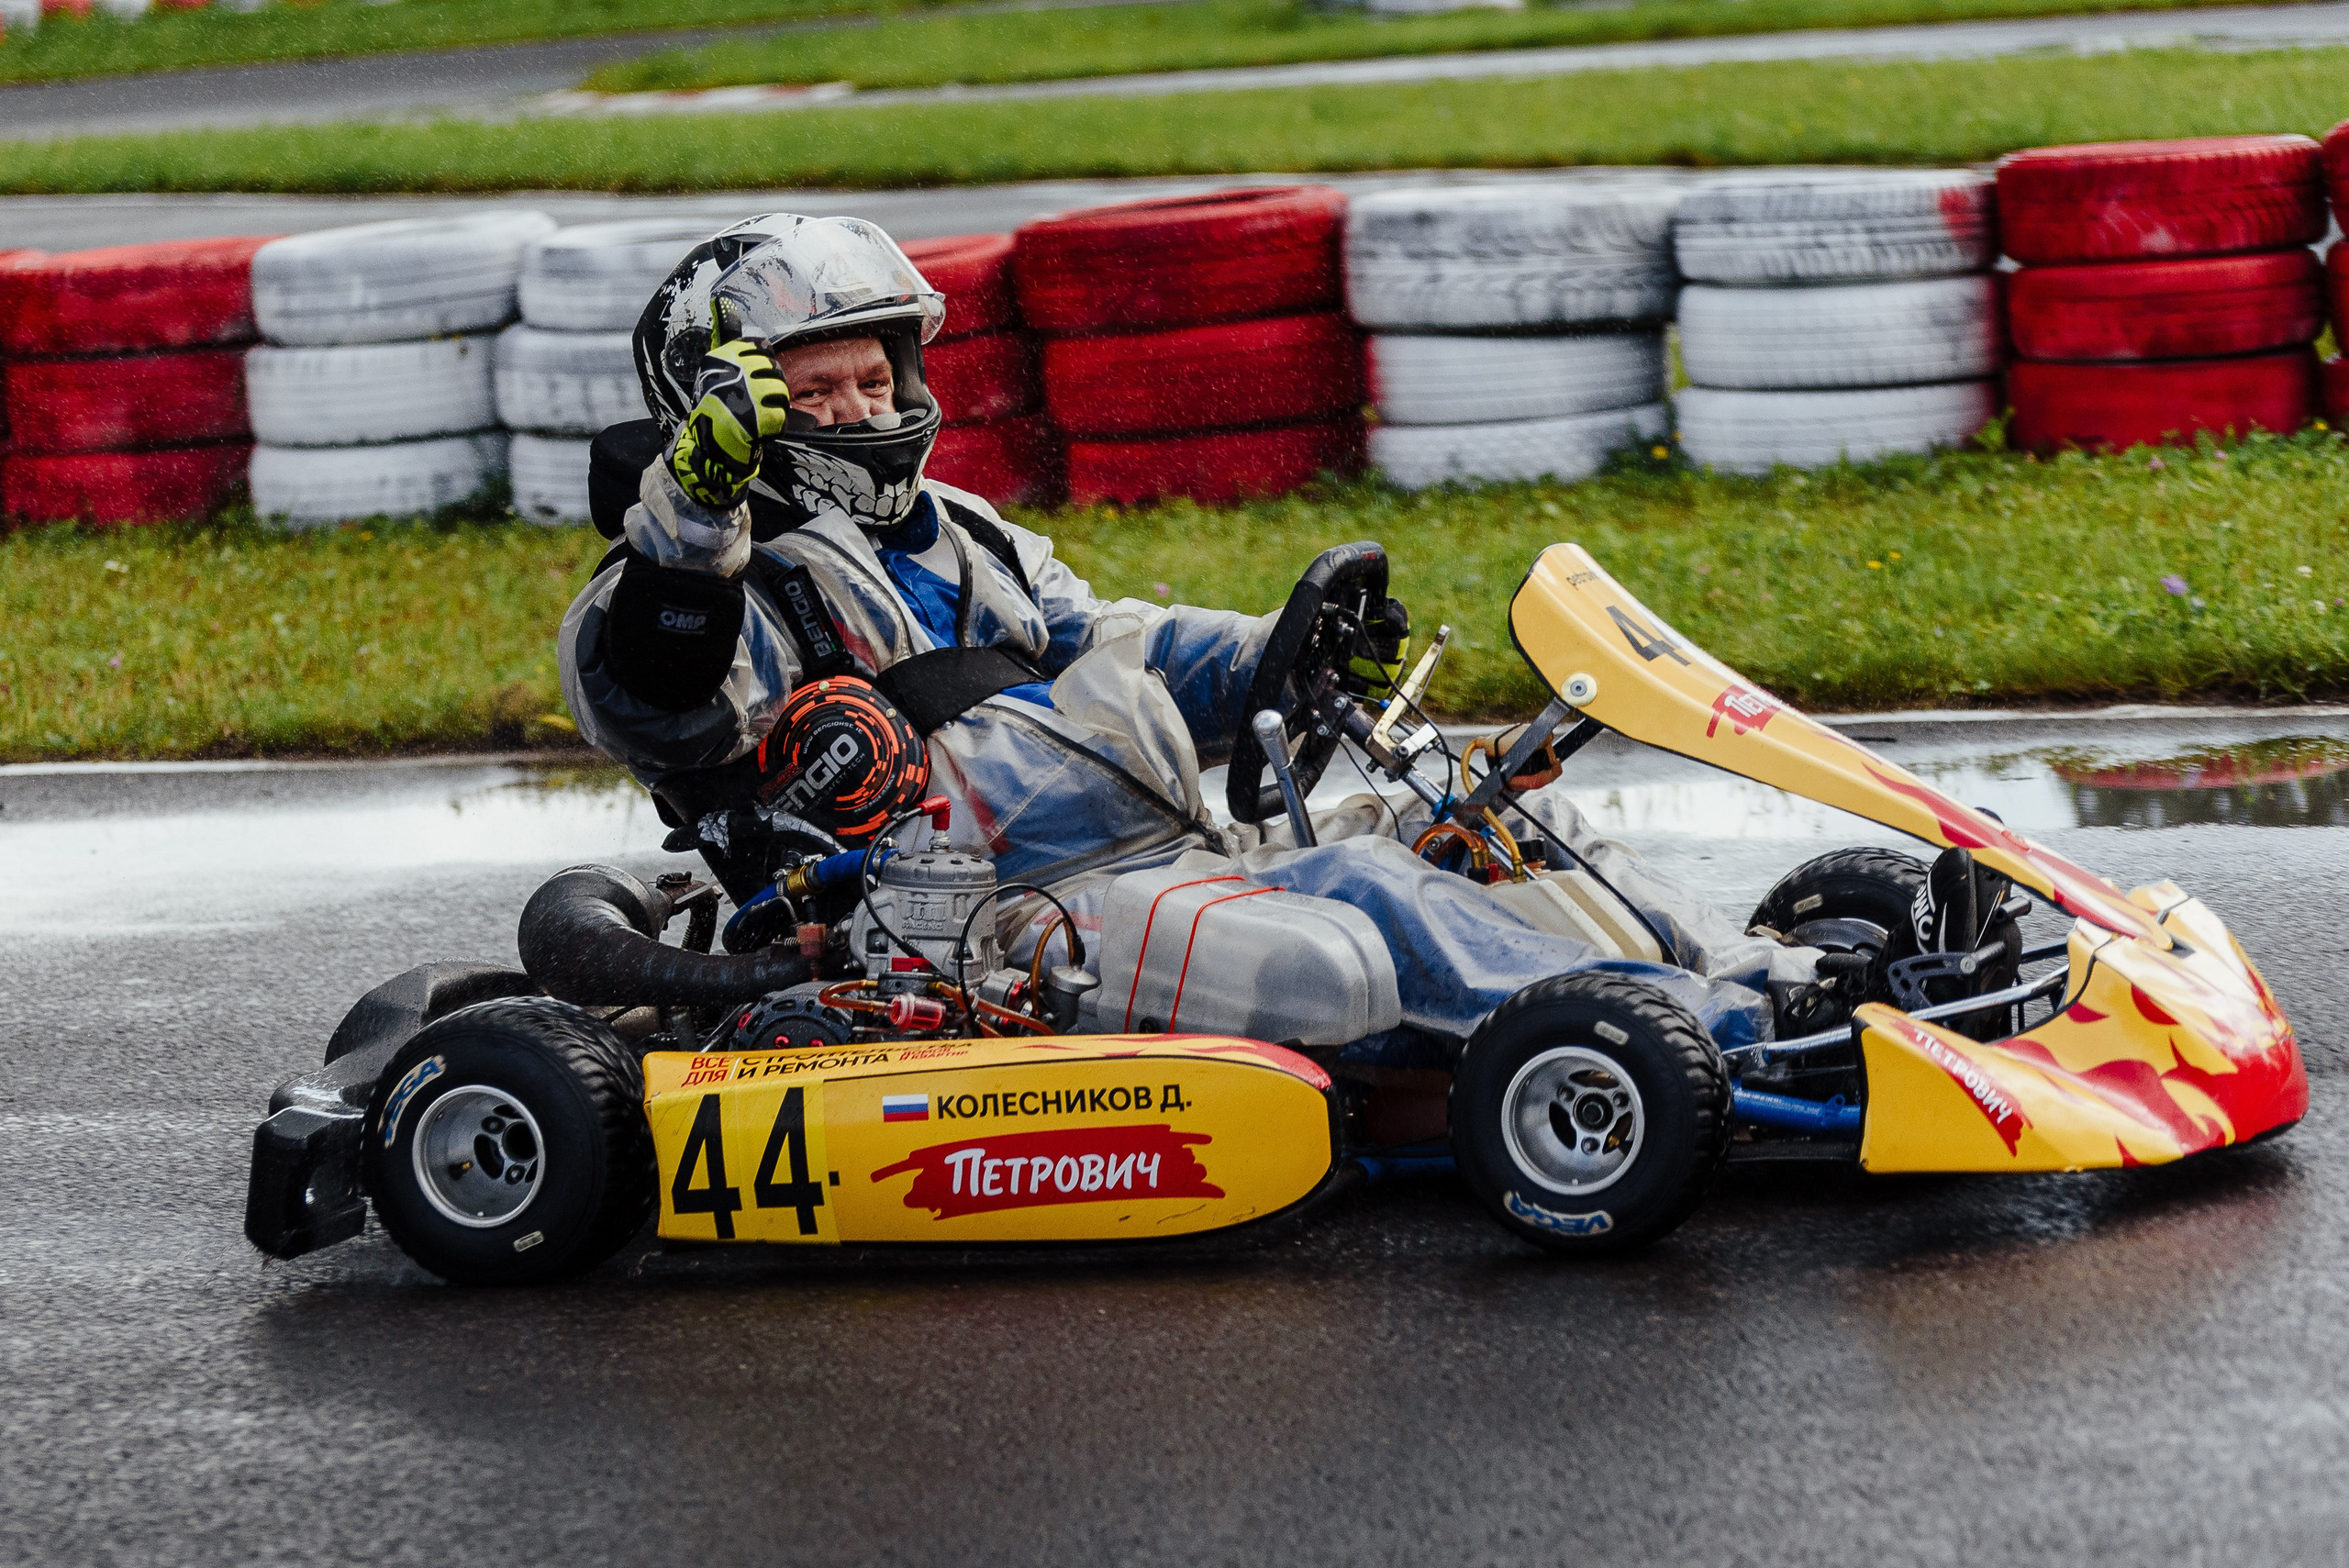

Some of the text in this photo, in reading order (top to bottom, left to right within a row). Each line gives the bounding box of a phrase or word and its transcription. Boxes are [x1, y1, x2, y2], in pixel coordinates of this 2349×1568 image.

[660, 610, 707, 629] OMP
[785, 581, 832, 657] BENGIO
[776, 733, 859, 811] ENGIO
[848, 752, 866, 772] TECH
[681, 1070, 727, 1087] ДЛЯ
[691, 1055, 731, 1070] ВСЕ
[737, 1053, 889, 1079] И РЕМОНТА
[1914, 1027, 2013, 1125] ПЕТРОВИЧ
[936, 1084, 1193, 1120] КОЛЕСНИКОВ Д.
[672, 1086, 832, 1240] 44
[943, 1147, 1163, 1196] ПЕТРОВИЧ
